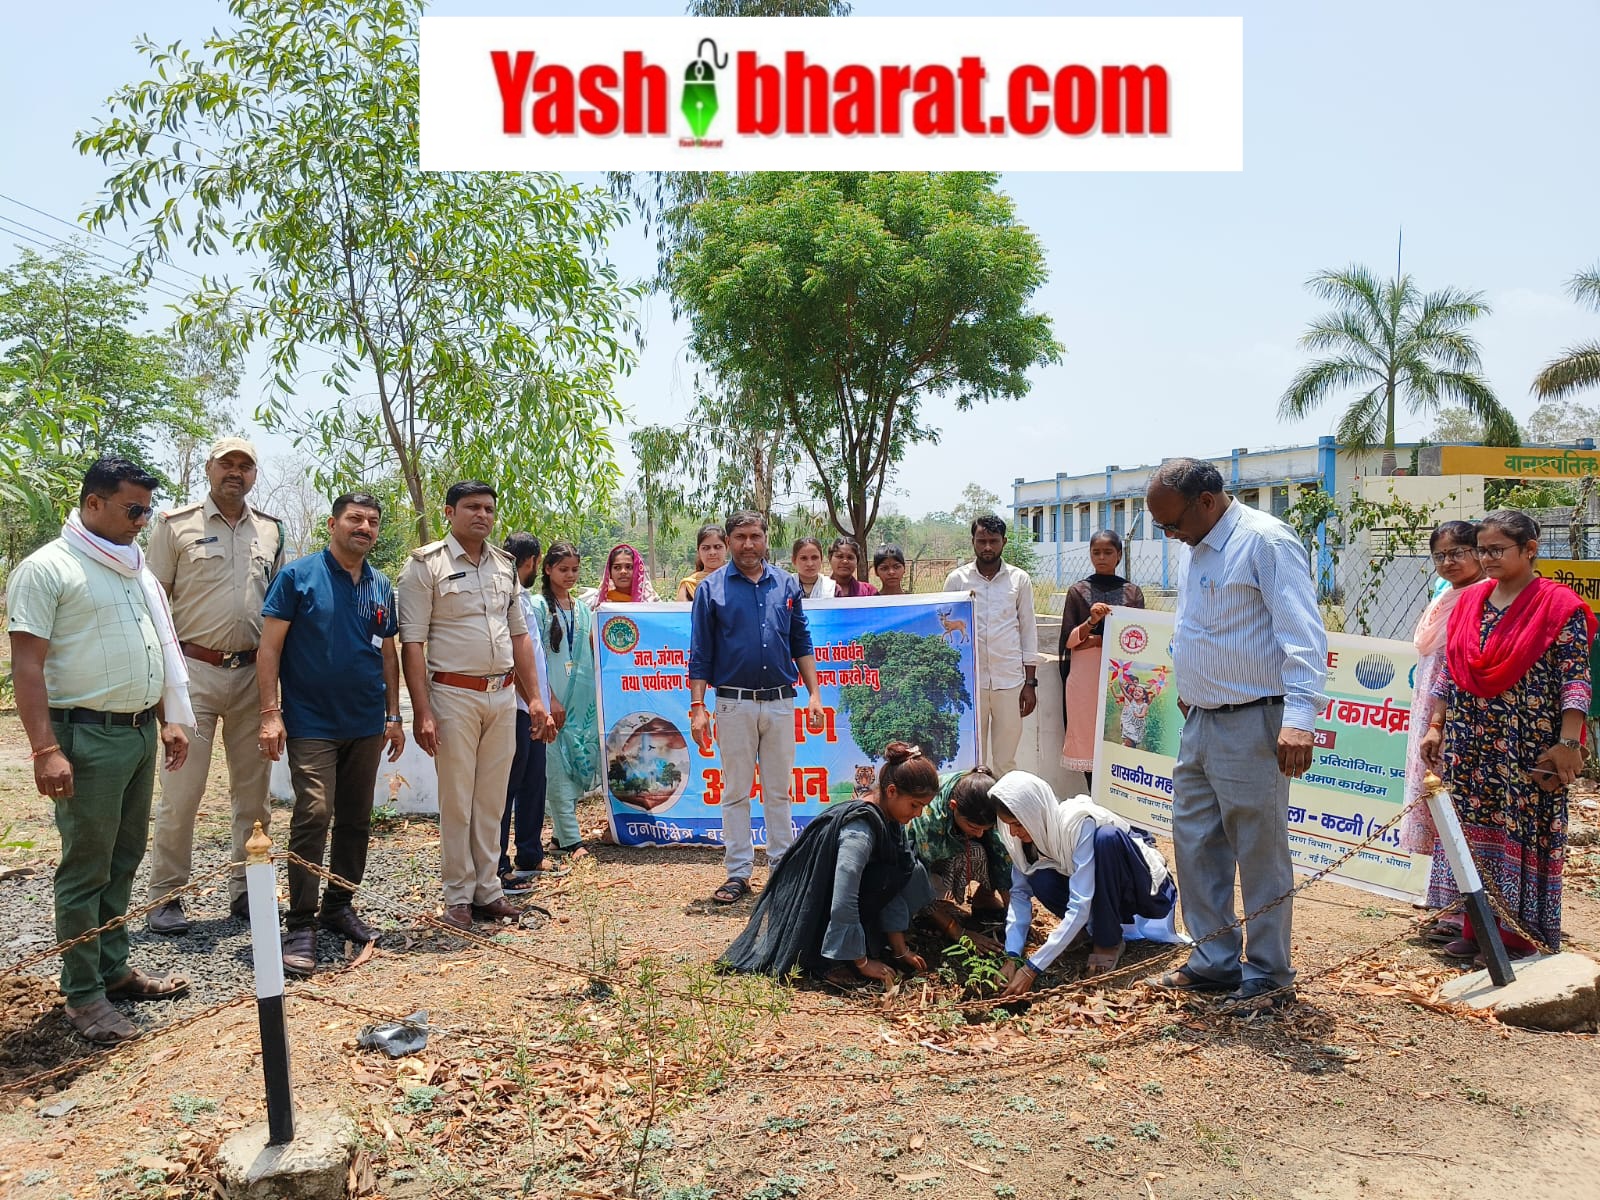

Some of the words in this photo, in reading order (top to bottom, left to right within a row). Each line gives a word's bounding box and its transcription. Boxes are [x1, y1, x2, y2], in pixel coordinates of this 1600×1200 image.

[814, 642, 830, 661] एवं
[832, 640, 864, 661] संवर्धन
[621, 675, 640, 690] तथा
[642, 670, 682, 690] पर्यावरण
[839, 665, 862, 685] करने
[863, 665, 881, 691] हेतु
[1337, 697, 1410, 733] कार्यक्र
[1314, 731, 1327, 744] 25
[1305, 772, 1336, 786] भ्रमण
[1338, 779, 1387, 796] कार्यक्रम
[1111, 763, 1153, 787] शासकीय
[1288, 806, 1306, 823] ला
[1321, 813, 1364, 836] कटनी
